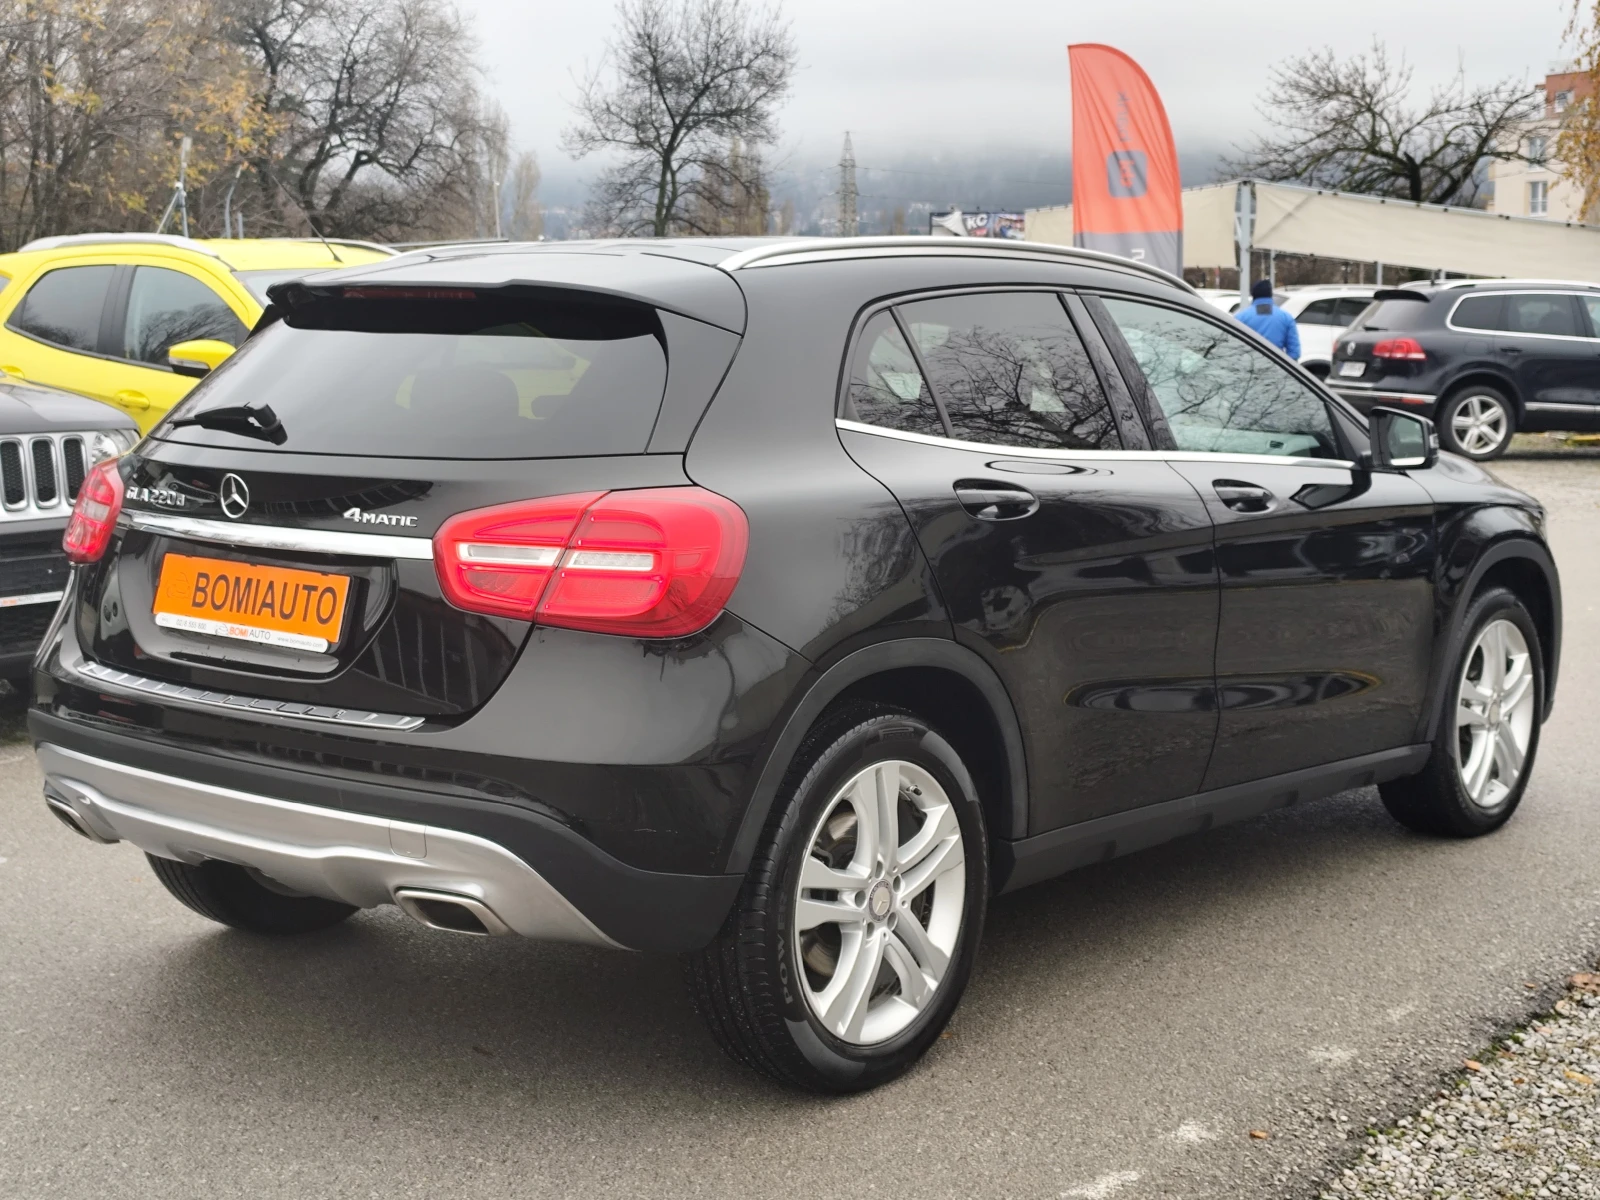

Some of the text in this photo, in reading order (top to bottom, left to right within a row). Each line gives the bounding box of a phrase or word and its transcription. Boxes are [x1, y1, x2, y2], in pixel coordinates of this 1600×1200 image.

[342, 507, 418, 528] 4MATIC
[191, 571, 338, 625] BOMIAUTO
[228, 625, 271, 641] BOMI AUTO
